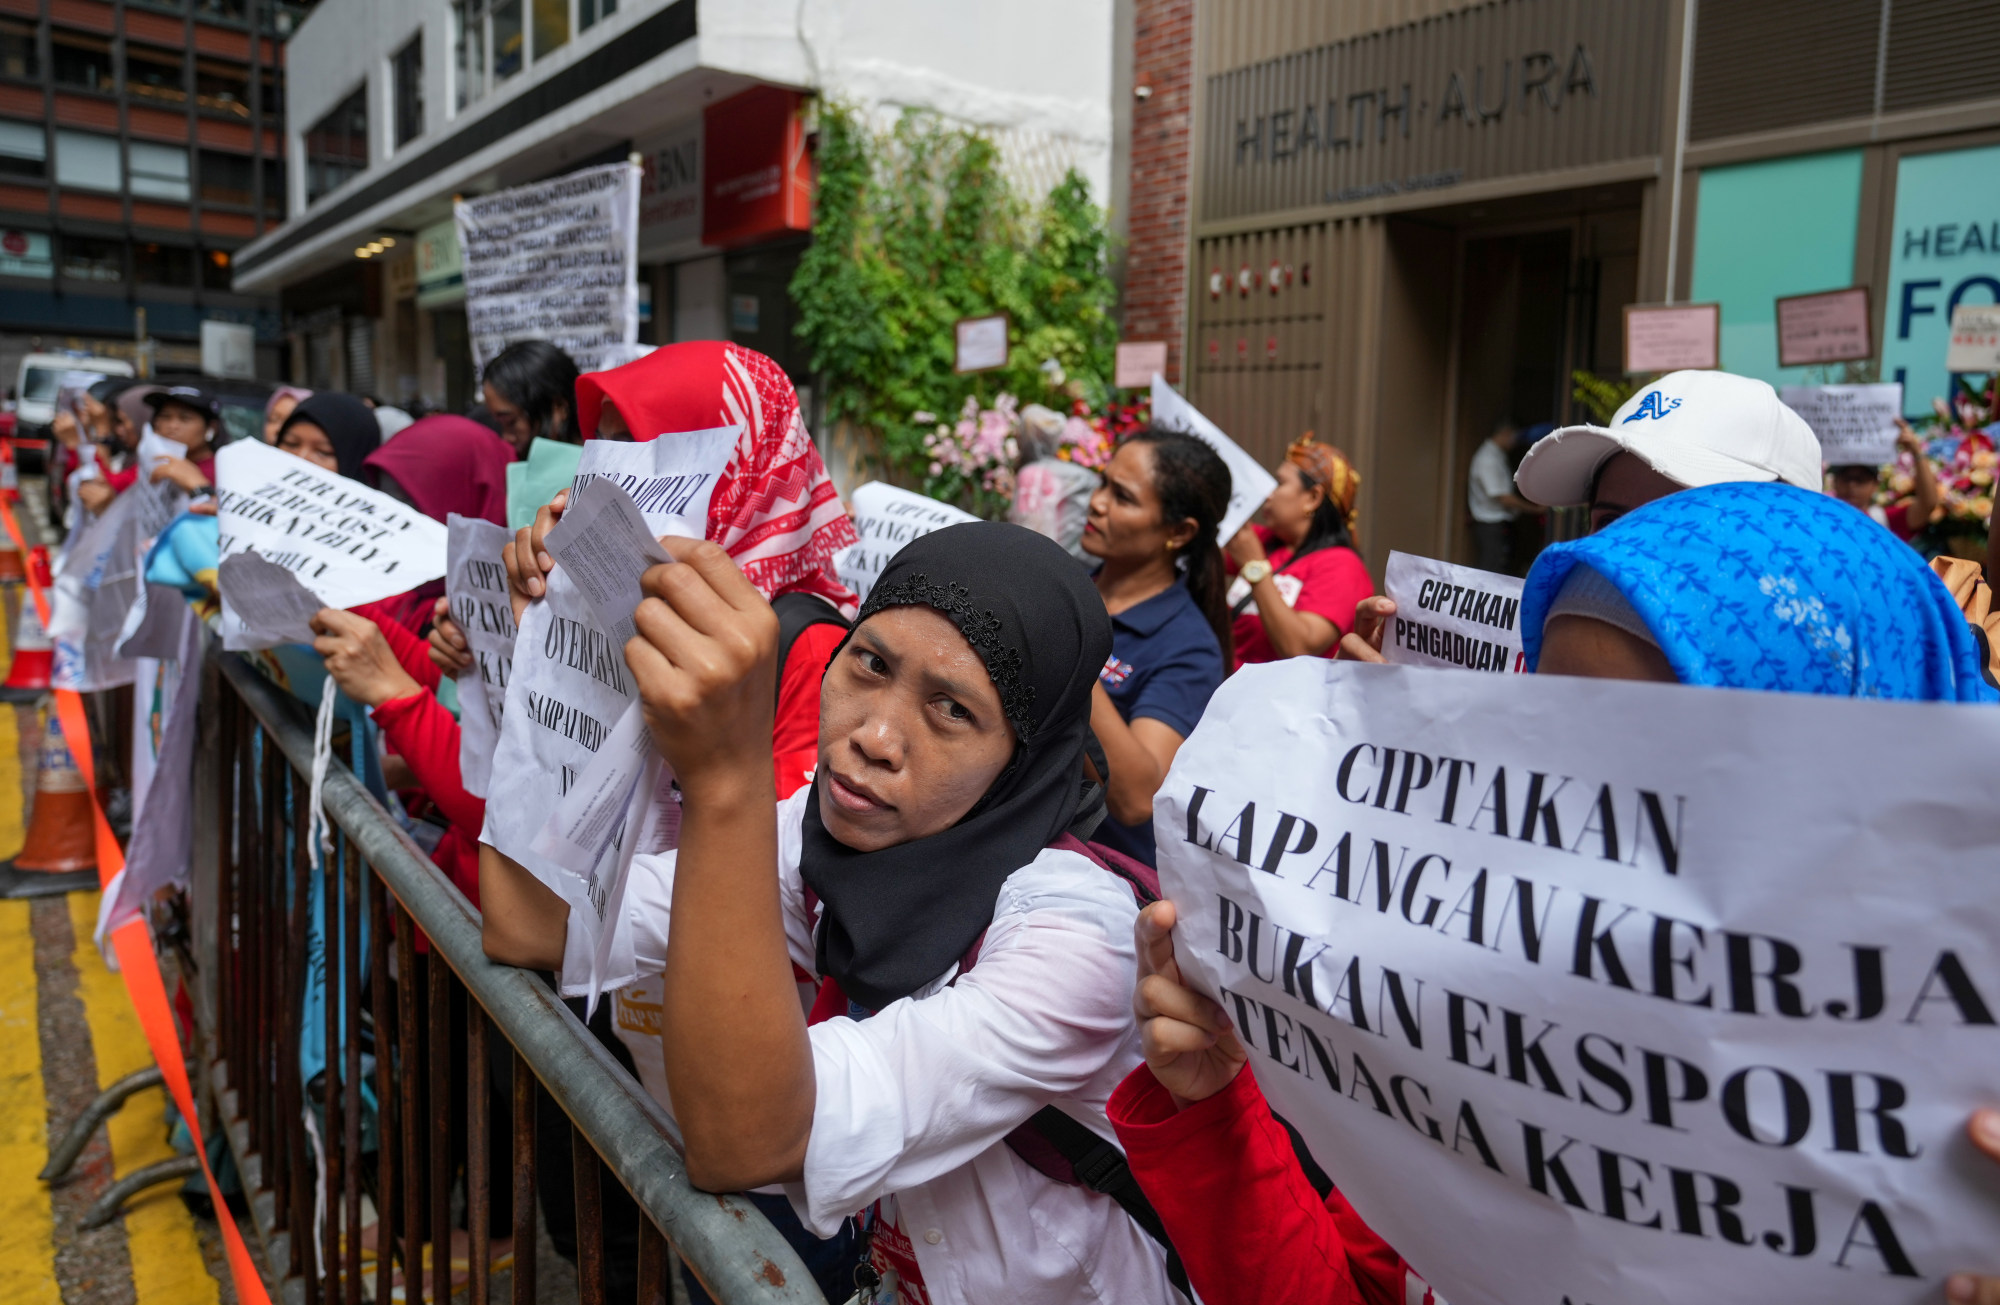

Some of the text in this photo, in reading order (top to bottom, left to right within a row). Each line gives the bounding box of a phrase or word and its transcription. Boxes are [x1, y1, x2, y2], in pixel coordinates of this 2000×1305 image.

[1236, 42, 1597, 164] HEALTH AURA
[1622, 391, 1683, 425] A's
[1396, 617, 1509, 673] PENGADUAN
[1418, 579, 1519, 631] CIPTAKAN
[1336, 742, 1686, 876] CIPTAKAN
[1184, 784, 2000, 1027] LAPANGAN KERJA
[1216, 893, 1925, 1160] BUKAN EKSPOR
[1219, 984, 1927, 1280] TENAGA KERJA
